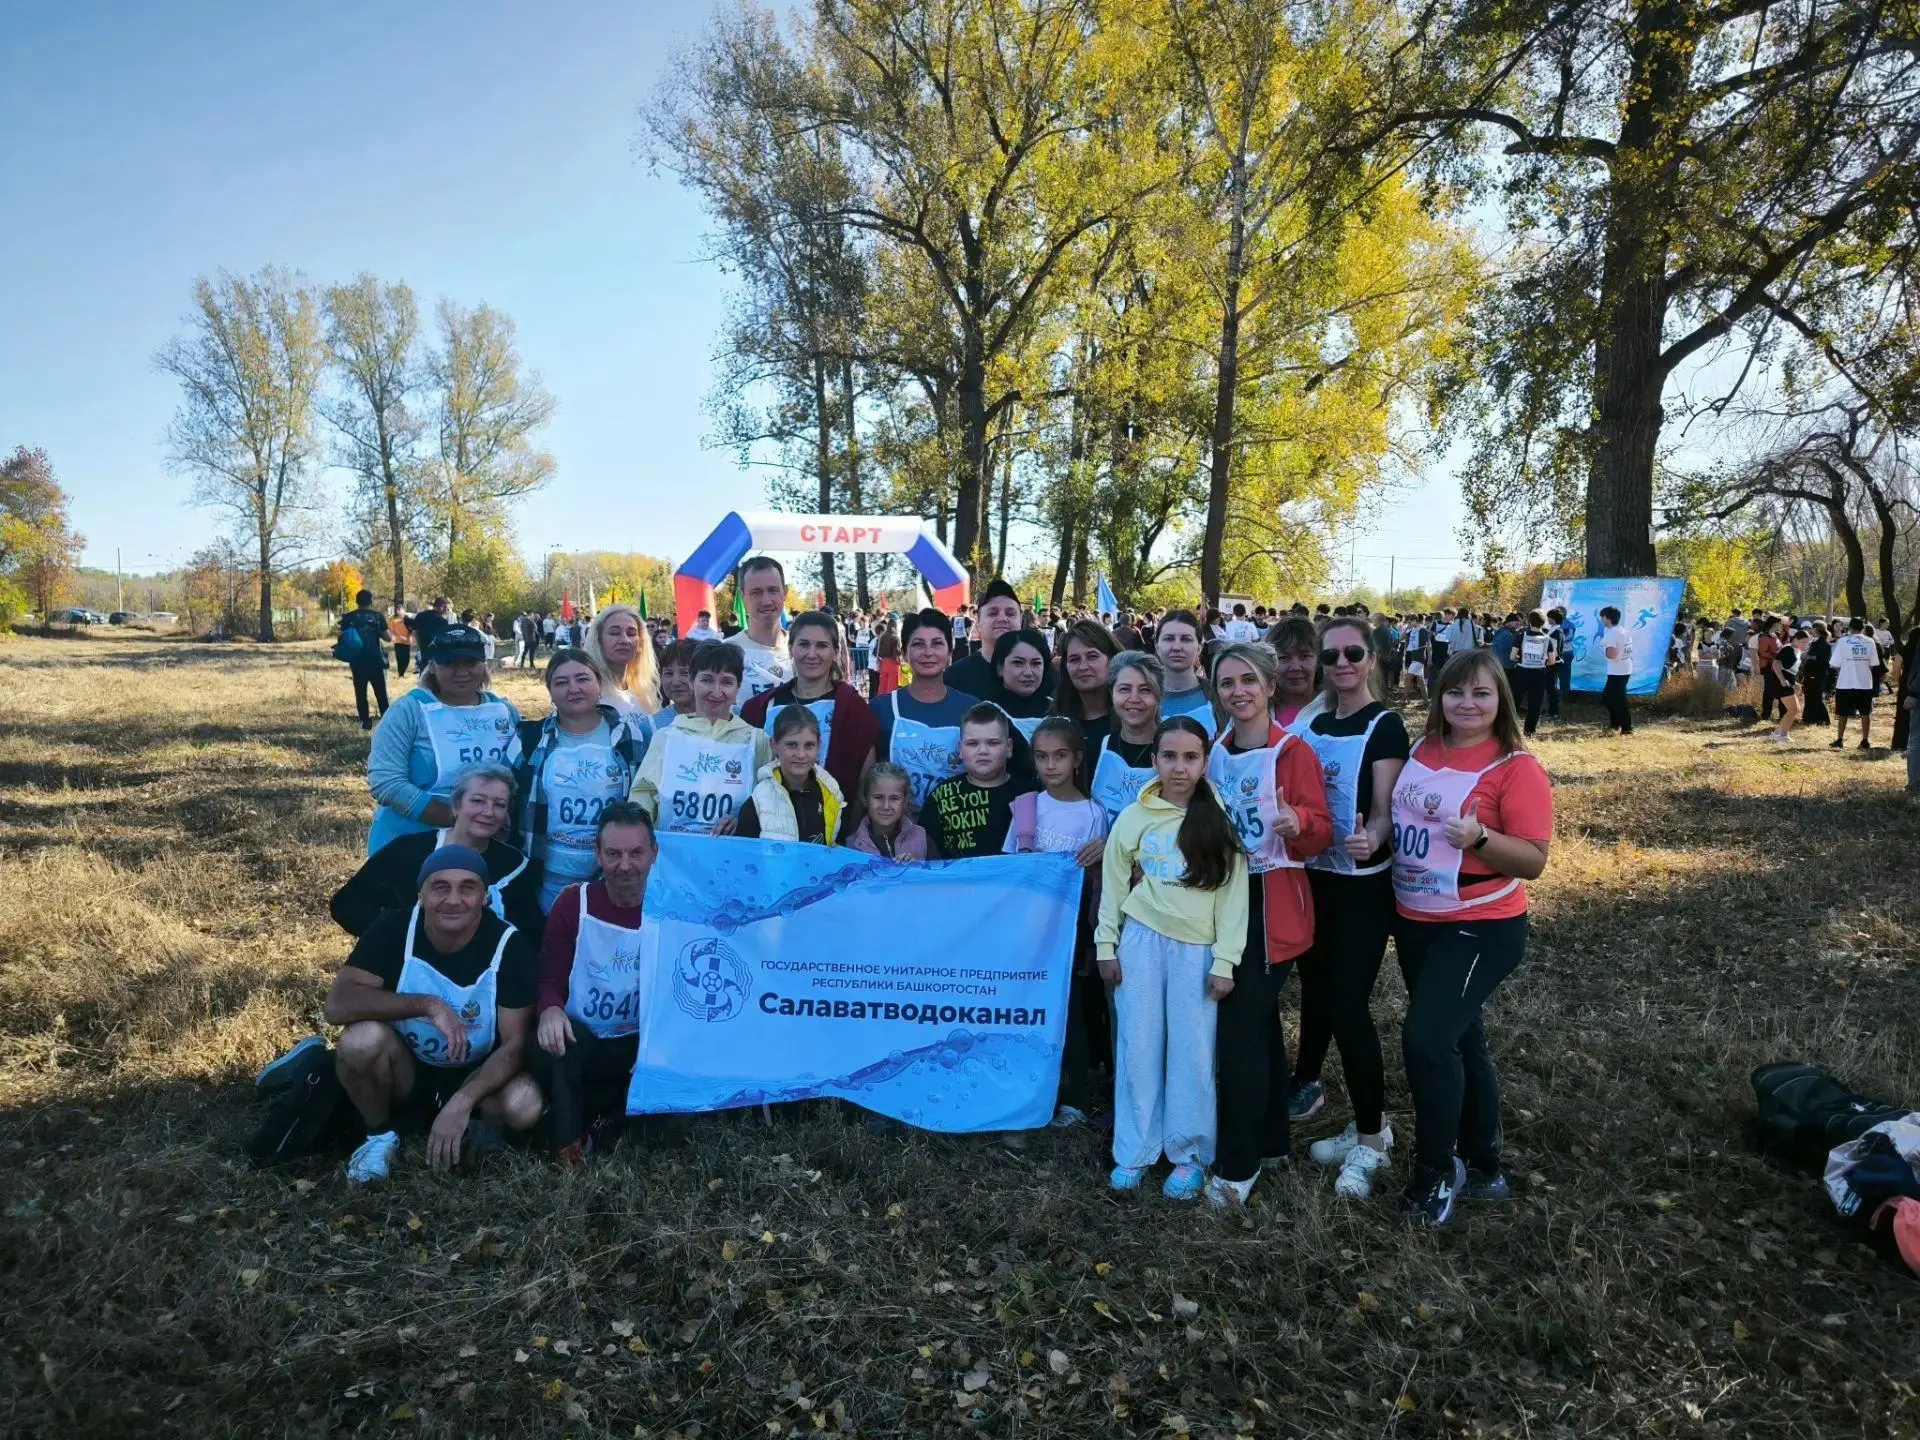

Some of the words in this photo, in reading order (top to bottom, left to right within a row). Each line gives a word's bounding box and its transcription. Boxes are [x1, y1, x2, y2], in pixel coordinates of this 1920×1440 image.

[800, 525, 882, 544] СТАРТ
[931, 780, 962, 802] WHY
[959, 790, 989, 809] YOU
[560, 796, 617, 826] 622
[672, 790, 733, 821] 5800
[957, 831, 977, 849] ME
[760, 960, 880, 975] ГОСУДАРСТВЕННОЕ
[883, 965, 957, 978] УНИТАРНОЕ
[960, 968, 1048, 981] ПРЕДПРИЯТИЕ
[812, 978, 893, 990] РЕСПУБЛИКИ
[896, 981, 997, 996] БАШКОРТОСТАН
[758, 992, 1046, 1026] Салаватводоканал
